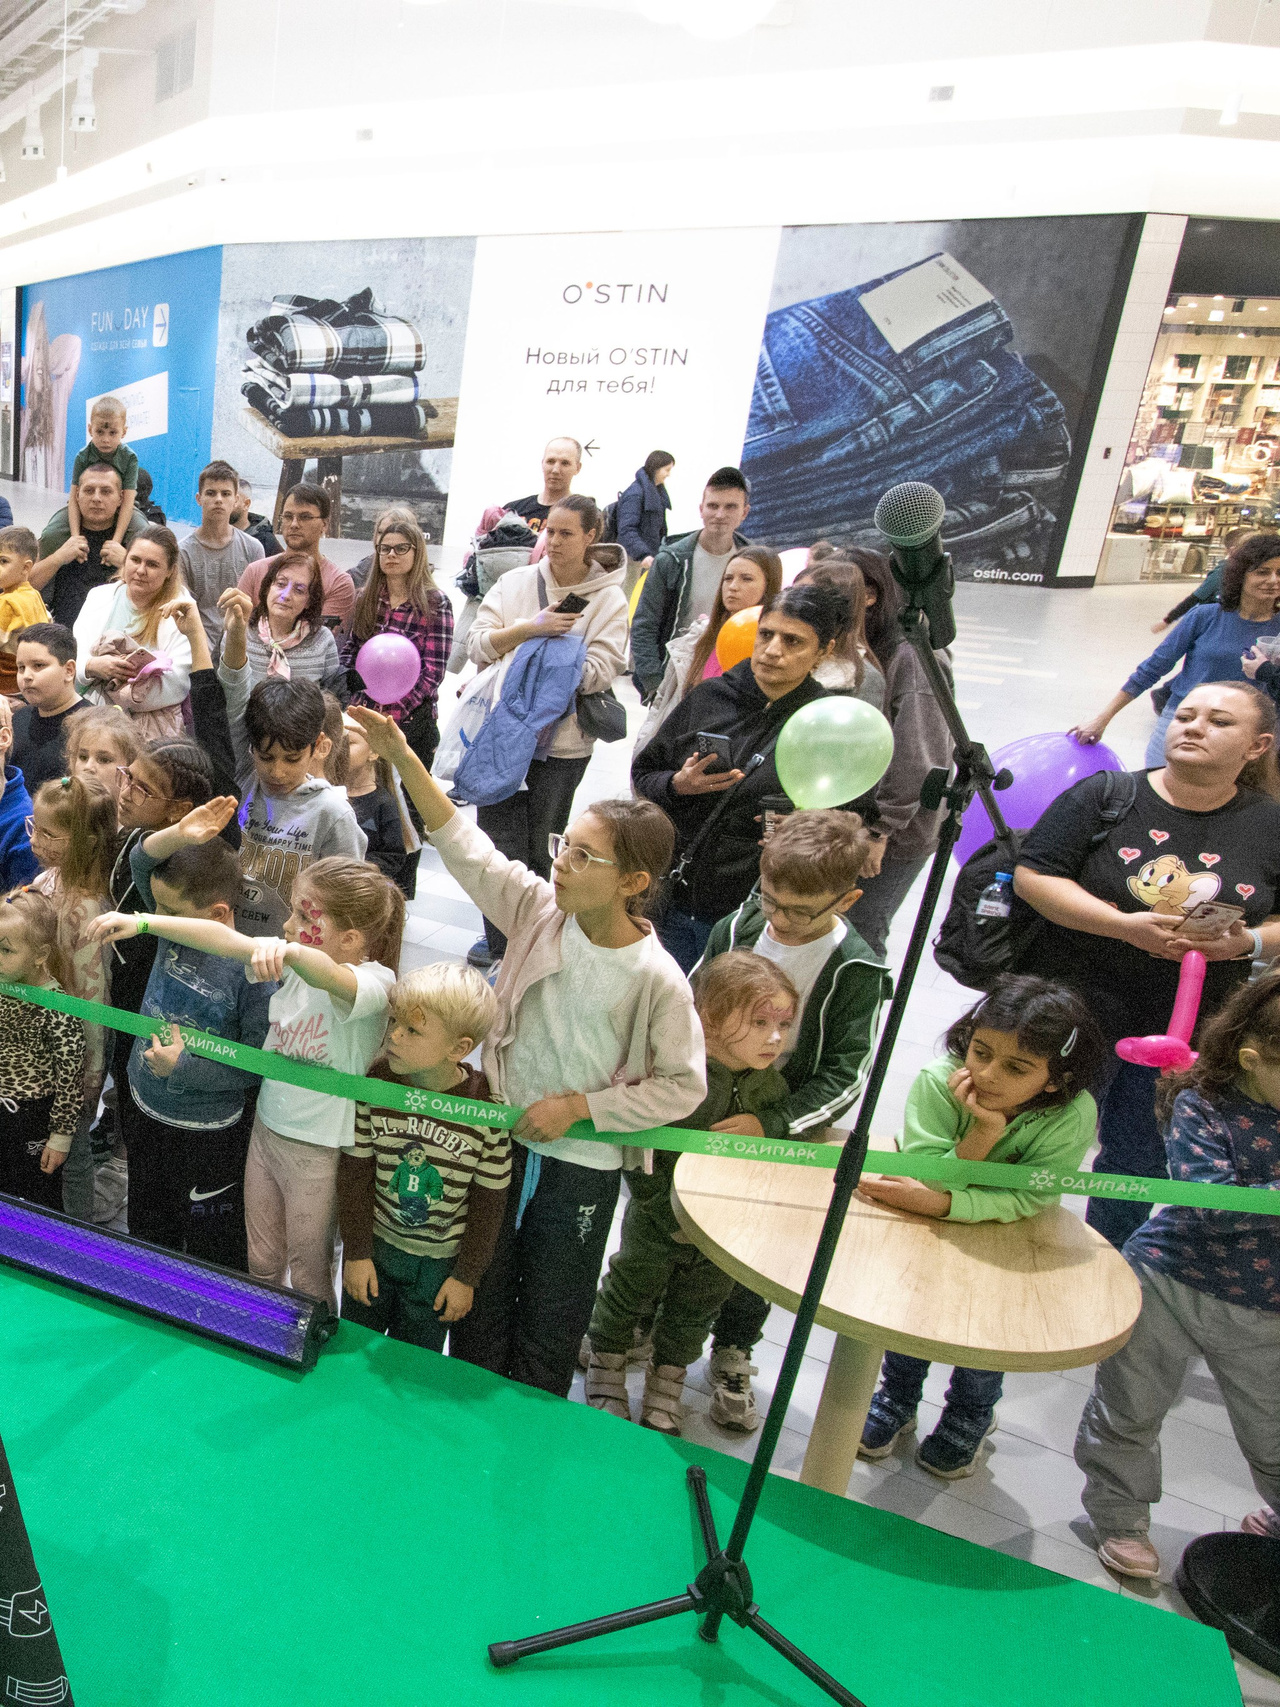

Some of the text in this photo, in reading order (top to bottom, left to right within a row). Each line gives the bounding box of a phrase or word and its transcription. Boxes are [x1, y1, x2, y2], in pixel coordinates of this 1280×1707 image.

[91, 305, 149, 332] FUN DAY
[526, 347, 689, 365] Новый O'STIN
[546, 375, 656, 395] для тебя!
[973, 569, 1044, 582] ostin.com
[261, 819, 284, 836] Your
[287, 825, 309, 841] Life
[268, 835, 291, 848] HAPPY
[431, 1098, 508, 1123] ОДИПАРК
[406, 1116, 473, 1158] RUGBY
[734, 1141, 818, 1160] ОДИПАРК
[407, 1174, 420, 1192] B
[1061, 1176, 1150, 1196] ОДИПАРК
